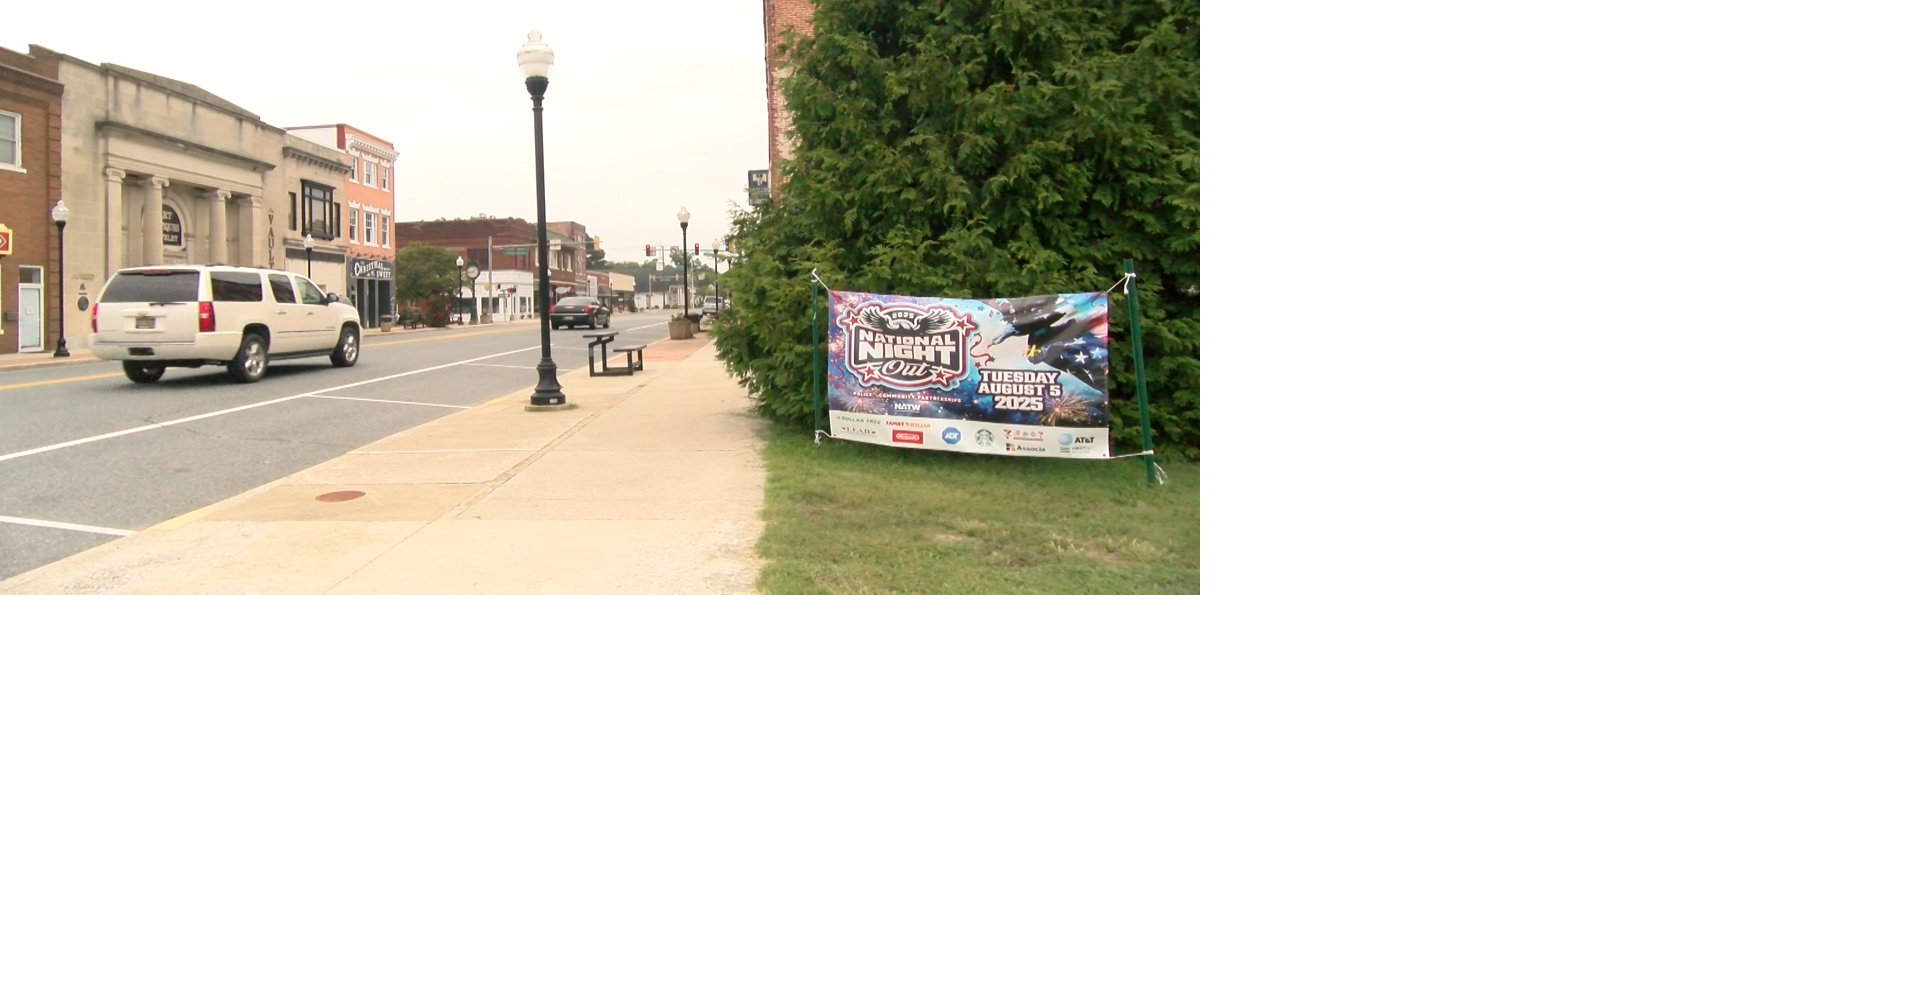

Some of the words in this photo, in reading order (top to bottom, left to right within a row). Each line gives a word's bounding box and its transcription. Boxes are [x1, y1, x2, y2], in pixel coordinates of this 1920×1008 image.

[376, 270, 391, 278] SWEET
[892, 311, 915, 319] 2025
[860, 329, 956, 346] NATIONAL
[859, 341, 956, 365] NIGHT
[881, 360, 931, 376] Out
[980, 370, 1058, 384] TUESDAY
[978, 383, 1044, 396] AUGUST
[1049, 385, 1061, 396] 5
[917, 395, 962, 403] PARTNERSHIPS
[994, 396, 1044, 411] 2025
[894, 403, 921, 411] NATW
[841, 415, 865, 423] DOLLAR
[944, 432, 959, 440] ADT
